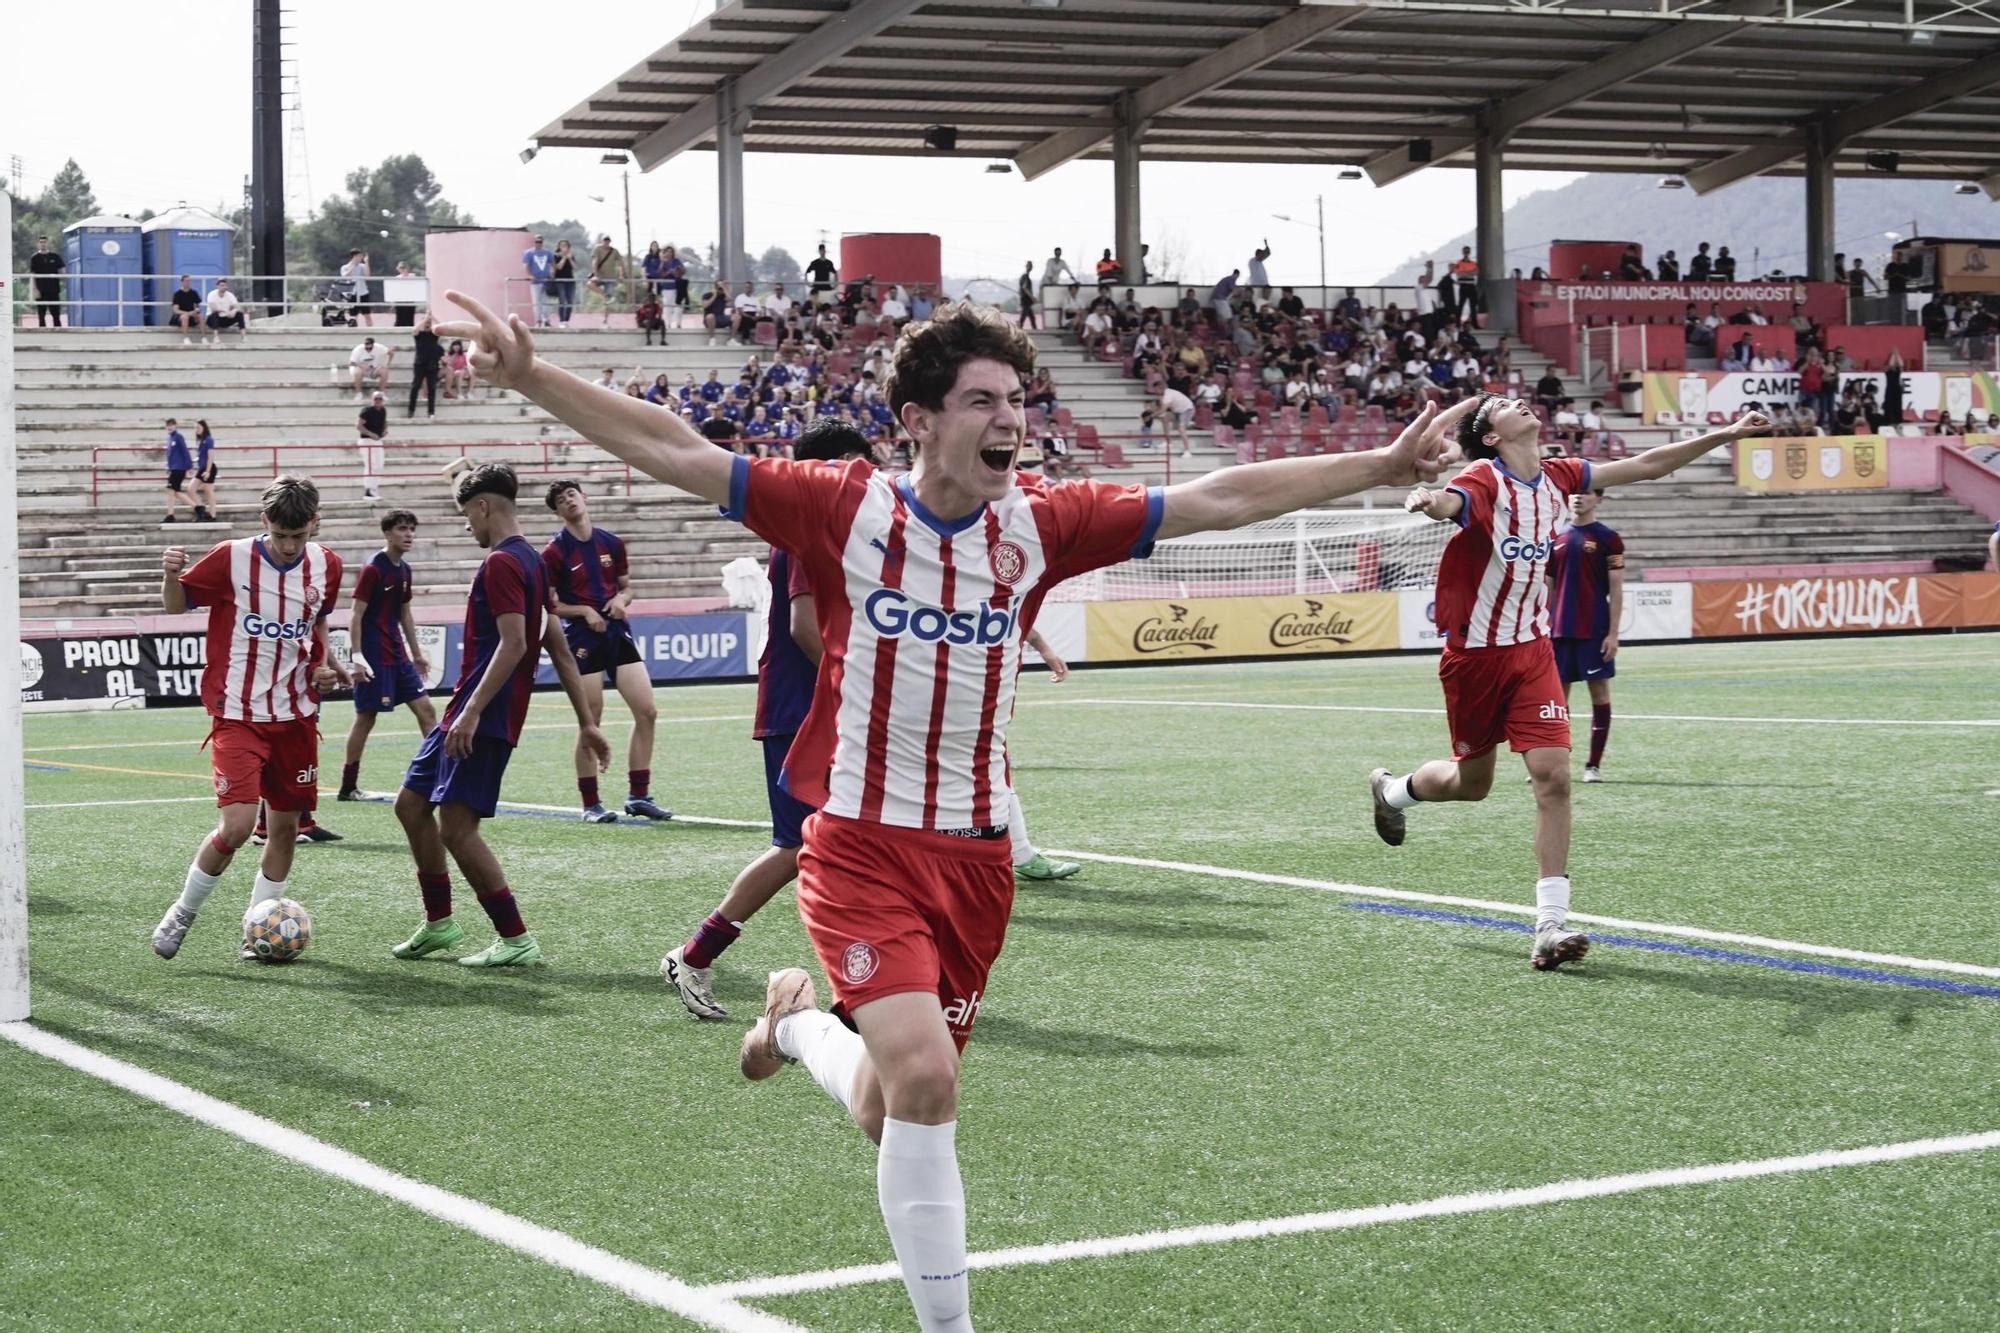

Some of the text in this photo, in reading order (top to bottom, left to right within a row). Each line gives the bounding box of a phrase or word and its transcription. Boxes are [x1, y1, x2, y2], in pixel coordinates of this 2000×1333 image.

[1557, 285, 1793, 300] ESTADI MUNICIPAL NOU CONGOST
[865, 589, 1021, 645] Gosbi
[1735, 577, 1923, 633] #ORGULLOSA
[1133, 616, 1219, 653] Cacaolat
[1269, 611, 1354, 648] Cacaolat
[64, 638, 142, 668] PROU
[654, 632, 738, 663] EQUIP
[106, 669, 146, 698] AL
